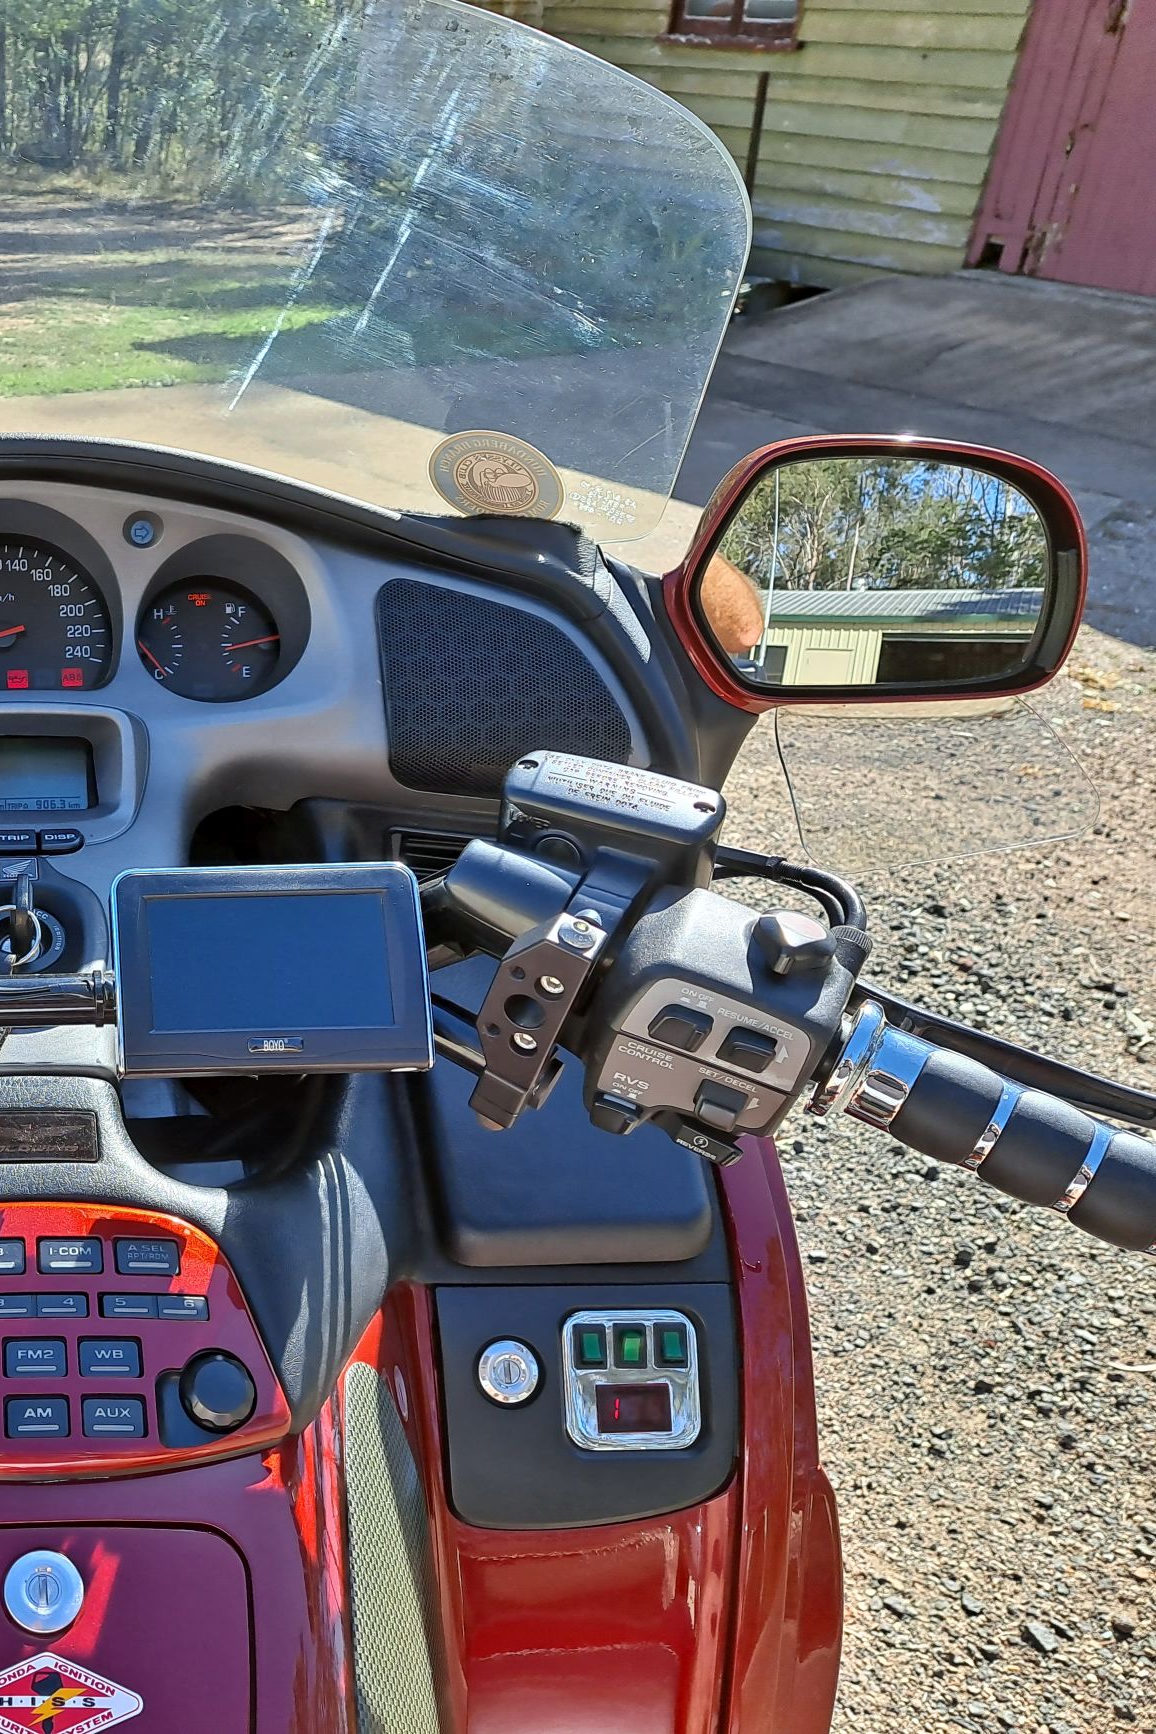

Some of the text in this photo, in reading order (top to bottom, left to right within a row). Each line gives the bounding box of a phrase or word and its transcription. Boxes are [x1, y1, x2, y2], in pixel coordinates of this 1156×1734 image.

[5, 559, 28, 571] 140
[30, 569, 52, 581] 160
[48, 584, 70, 597] 180
[59, 604, 84, 617] 200
[153, 609, 163, 619] H
[238, 606, 246, 617] F
[66, 624, 91, 637] 220
[65, 646, 90, 658] 240
[154, 668, 164, 680] C
[243, 666, 251, 677] E
[36, 799, 66, 809] 906.3
[0, 834, 30, 842] TRIP
[681, 987, 697, 998] ON
[717, 1007, 795, 1040] RESUME/ACCEL
[628, 1041, 674, 1061] CRUISE
[618, 1046, 674, 1070] CONTROL
[612, 1082, 627, 1090] ON
[613, 1072, 650, 1090] RVS
[699, 1067, 757, 1093] SET/DECEL
[676, 1138, 716, 1160] REVERSE
[49, 1247, 92, 1256] I-COM
[128, 1244, 137, 1252] A
[62, 1297, 75, 1306] 4
[115, 1298, 127, 1307] 5
[183, 1299, 195, 1308] 6
[16, 1349, 54, 1361] FM2
[94, 1348, 124, 1359] WB
[23, 1407, 53, 1419] AM
[94, 1407, 131, 1419] AUX
[53, 1661, 116, 1696] IGNITION
[62, 1711, 114, 1734] YSTEM
